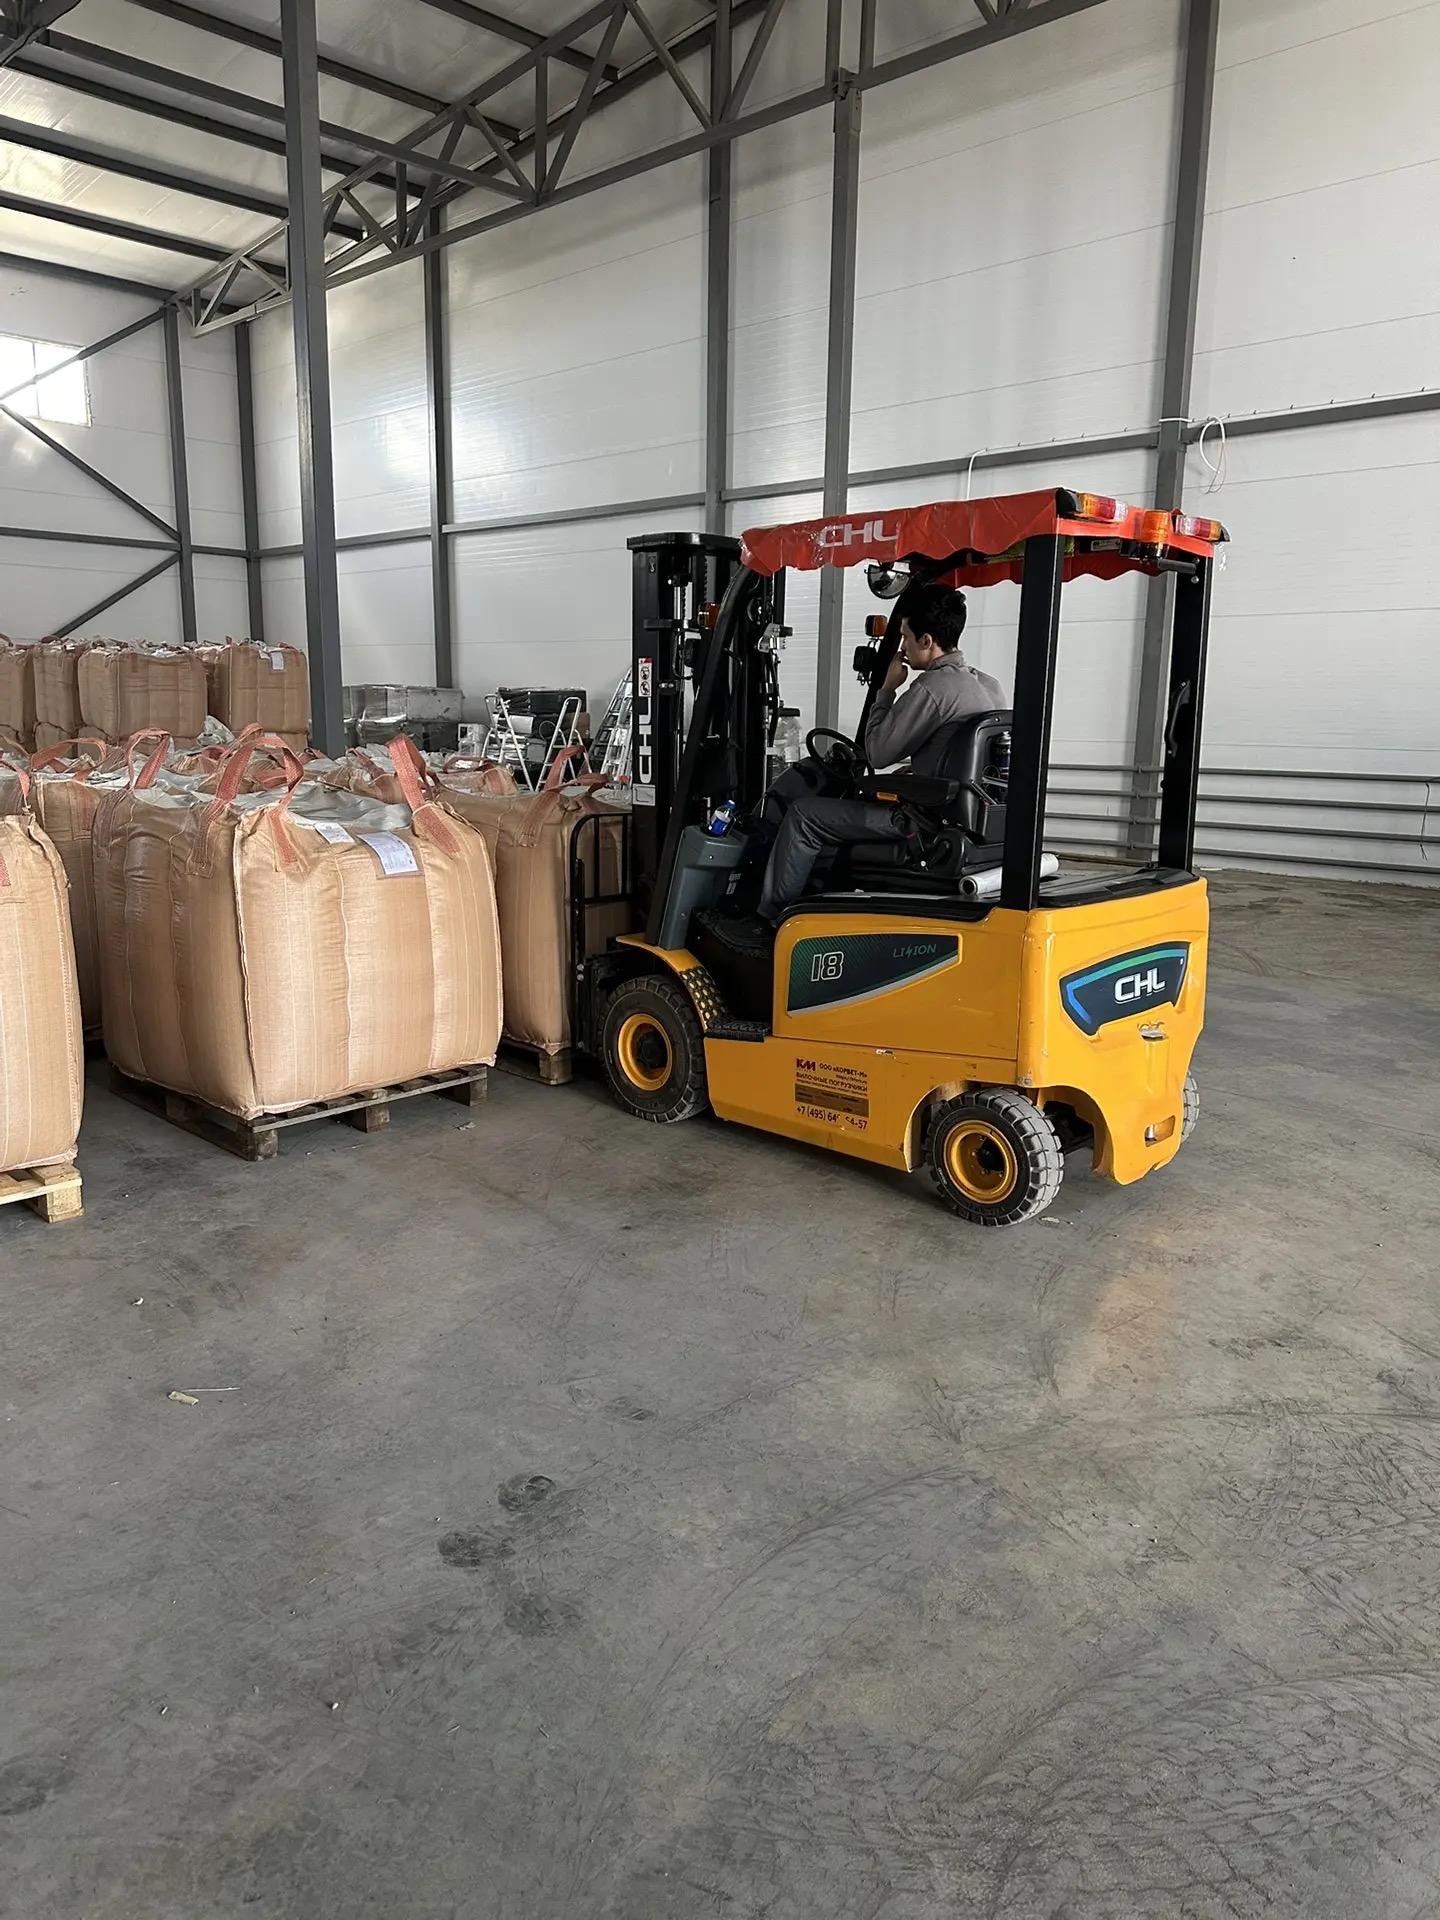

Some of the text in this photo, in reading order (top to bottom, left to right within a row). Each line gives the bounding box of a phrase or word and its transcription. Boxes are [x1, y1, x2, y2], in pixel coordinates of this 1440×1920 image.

[818, 519, 899, 548] CHL
[639, 697, 652, 784] CHL
[811, 951, 845, 982] 18
[1114, 967, 1166, 1004] CHL
[796, 1071, 828, 1084] ВИЛОЧНЫЕ
[829, 1078, 868, 1092] ПОГРУЗЧИКИ
[796, 1105, 806, 1115] +7
[807, 1106, 826, 1121] (495)
